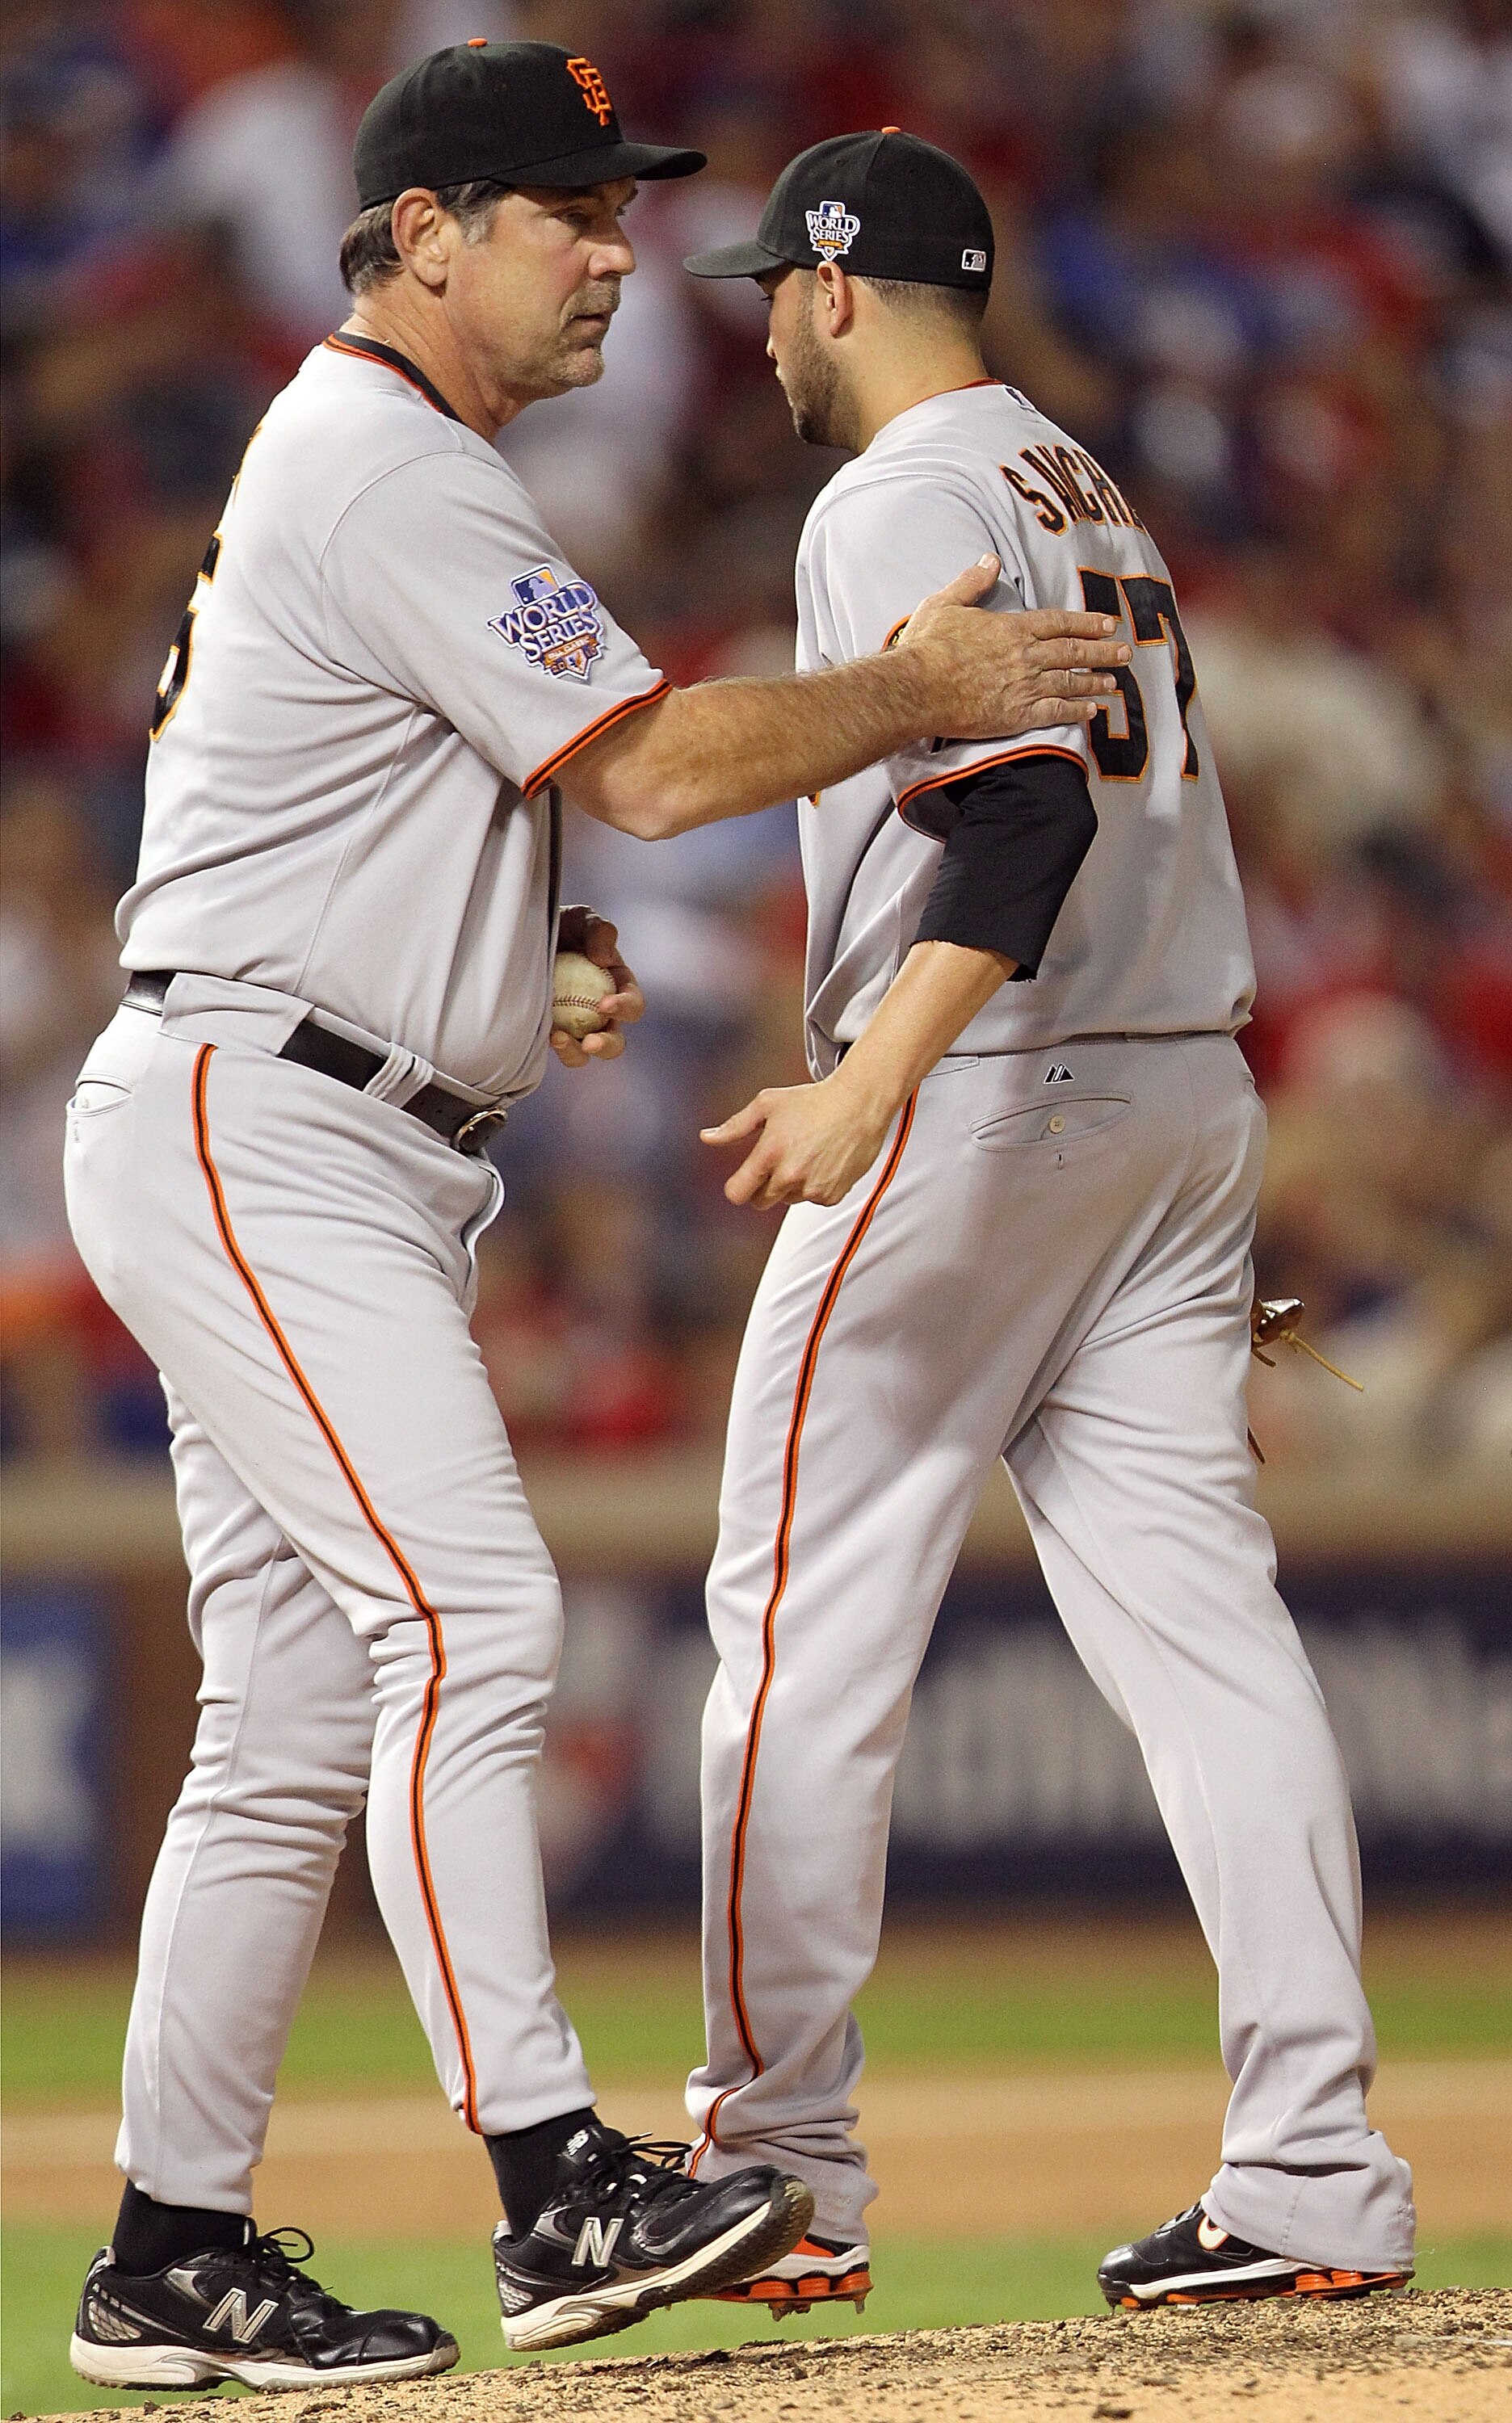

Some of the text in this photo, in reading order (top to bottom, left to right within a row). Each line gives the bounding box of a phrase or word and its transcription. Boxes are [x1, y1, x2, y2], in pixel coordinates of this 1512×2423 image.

[566, 57, 612, 127] SF
[808, 212, 857, 233] WORLD
[812, 226, 850, 243] SERIES
[489, 583, 595, 644] WORLD
[519, 607, 600, 663] SERIES
[1077, 565, 1200, 783] 57
[571, 2216, 624, 2268] N
[202, 2287, 279, 2345] N
